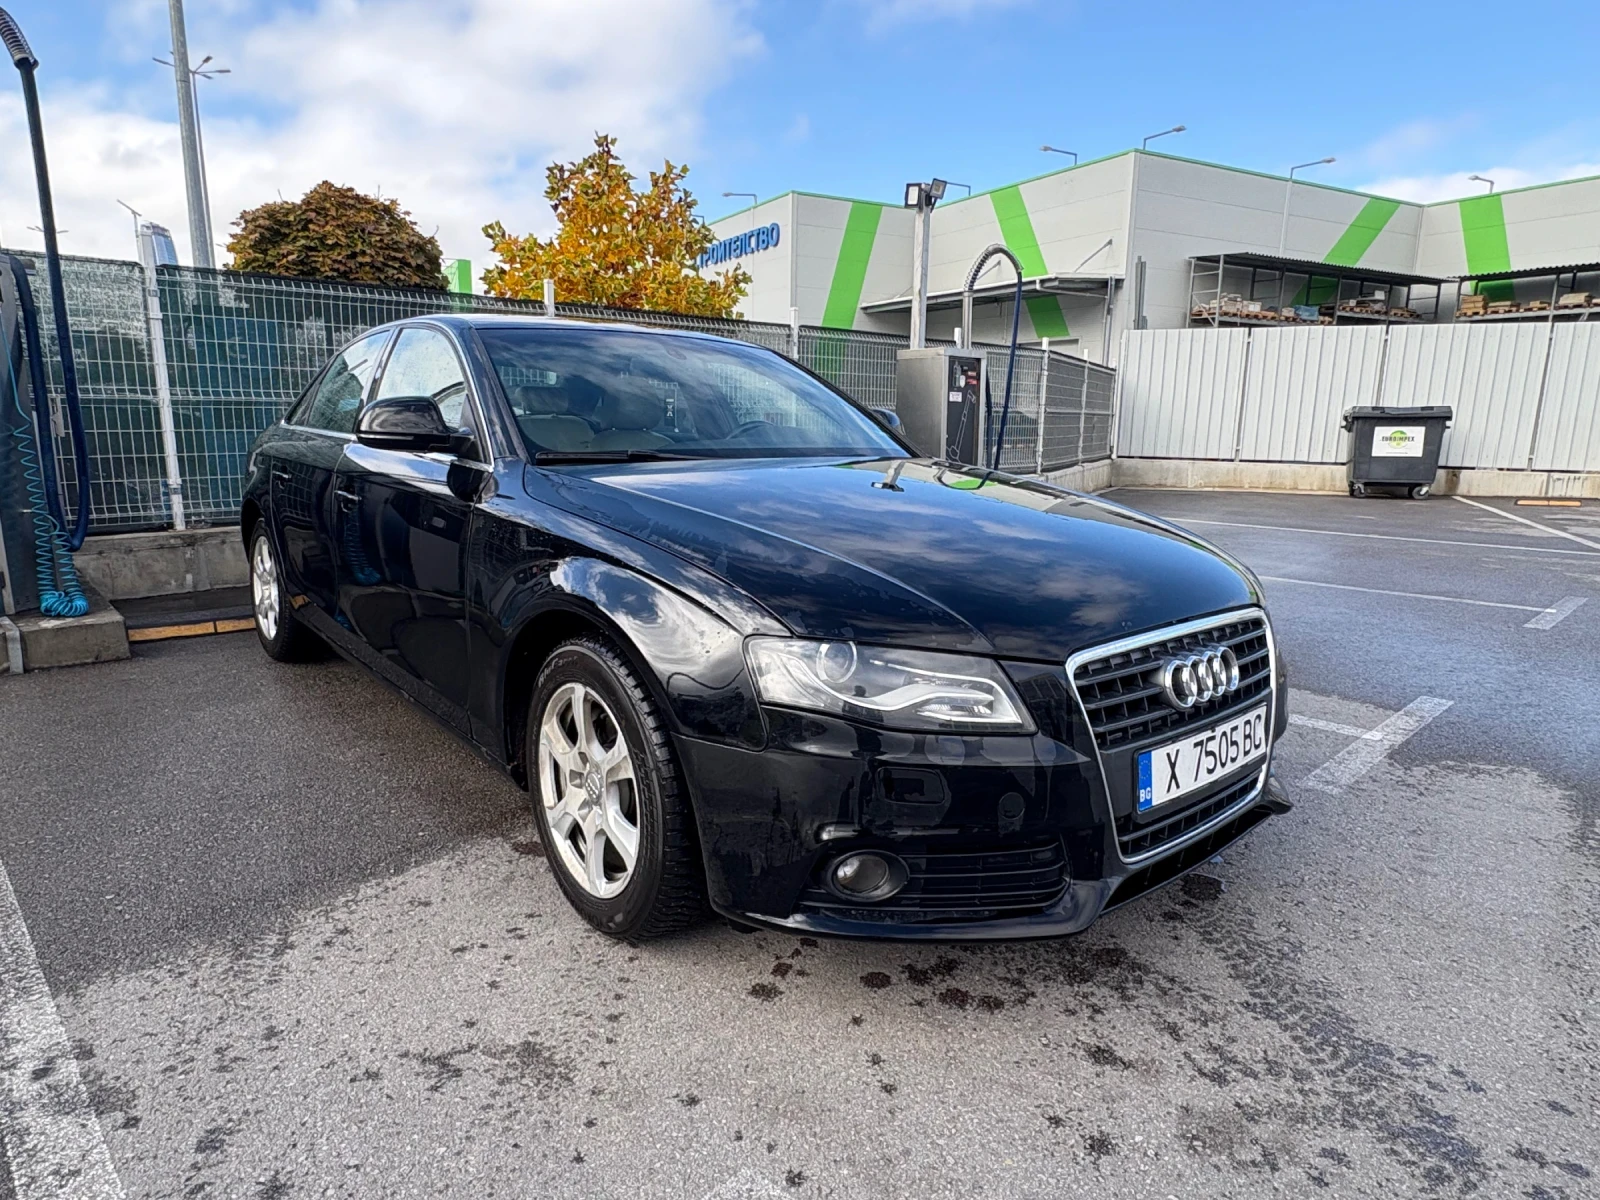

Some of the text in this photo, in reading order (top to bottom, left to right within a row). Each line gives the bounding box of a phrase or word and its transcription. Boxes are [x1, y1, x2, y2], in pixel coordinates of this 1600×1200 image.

[696, 222, 780, 269] РОИТЕЛСТВО
[1193, 725, 1239, 783] 7505
[1139, 787, 1152, 803] BG
